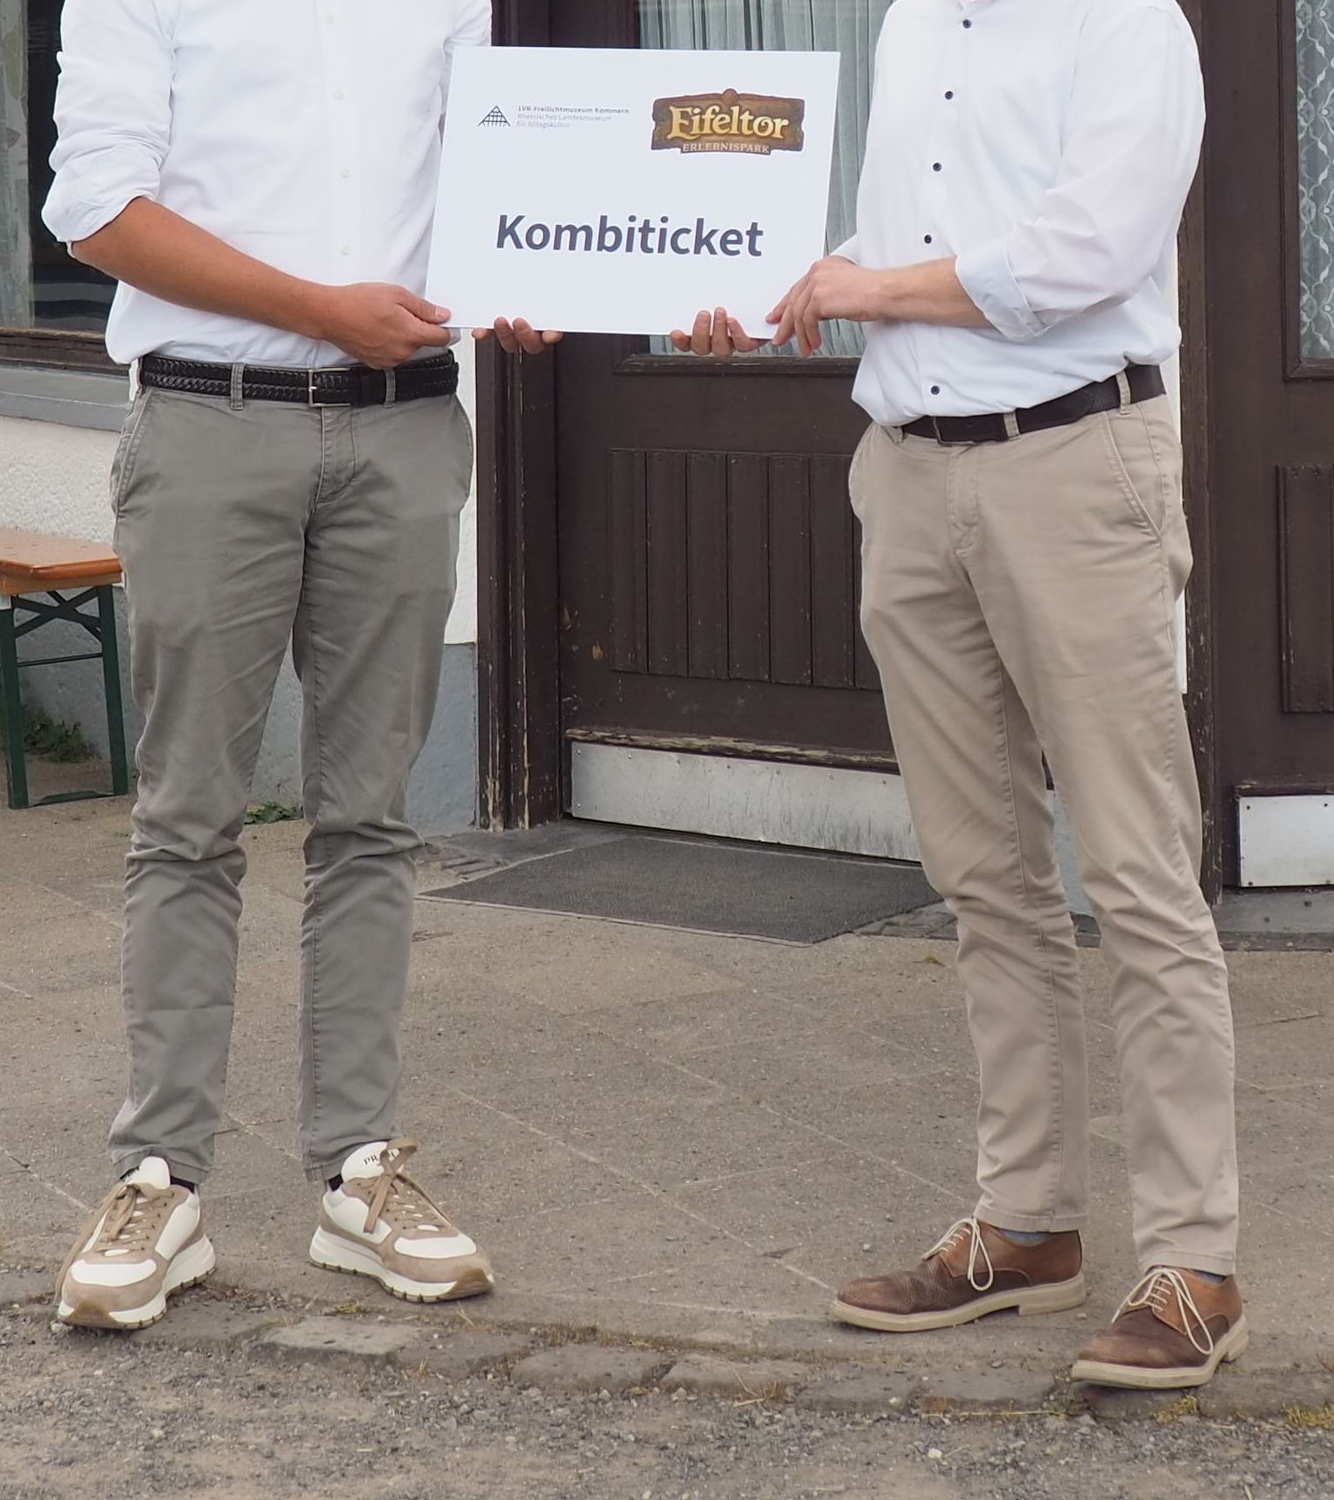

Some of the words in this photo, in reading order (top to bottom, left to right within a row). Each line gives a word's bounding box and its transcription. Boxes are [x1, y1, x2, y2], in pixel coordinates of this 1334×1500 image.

[667, 104, 789, 141] Eifeltor
[682, 141, 770, 155] ERLEBNISPARK
[495, 213, 764, 258] Kombiticket
